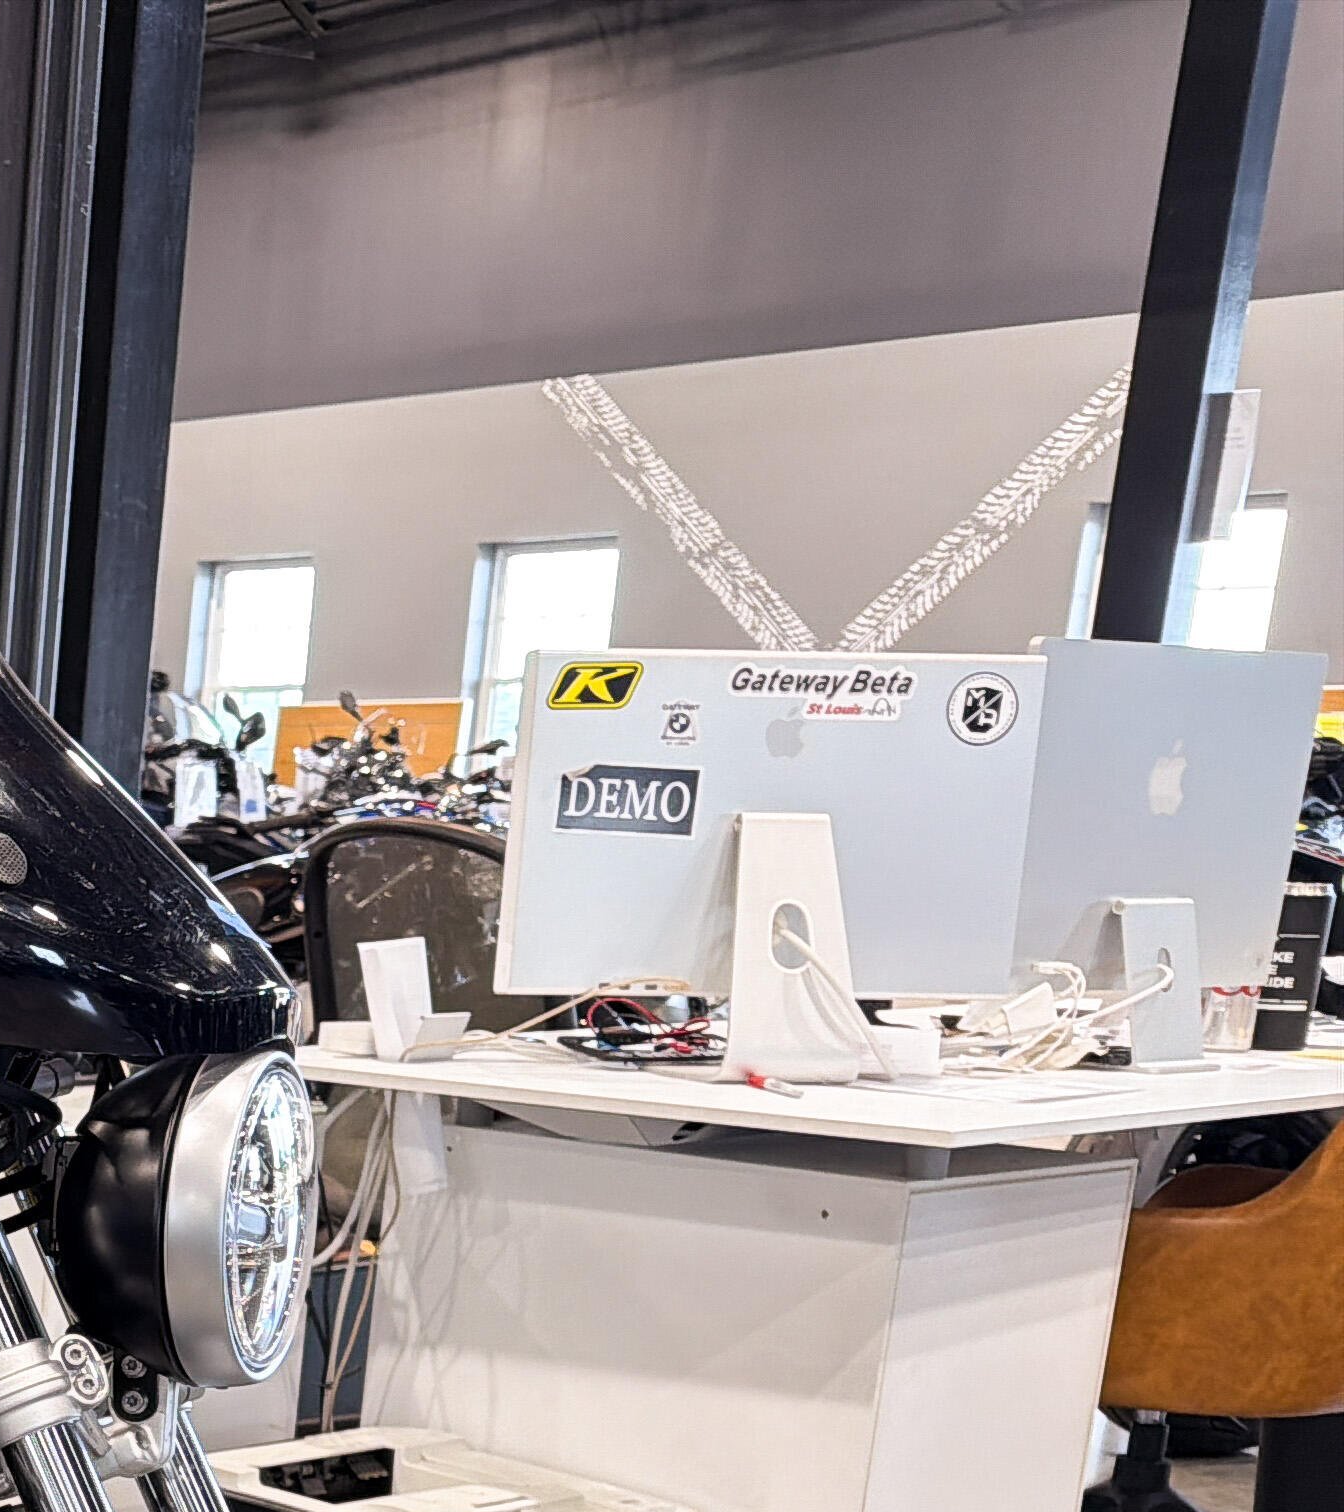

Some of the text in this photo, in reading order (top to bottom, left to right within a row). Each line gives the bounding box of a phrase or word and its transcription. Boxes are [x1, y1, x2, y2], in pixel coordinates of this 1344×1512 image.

[731, 667, 913, 700] Gateway Beta
[806, 703, 864, 716] St Louis
[562, 776, 691, 824] DEMO
